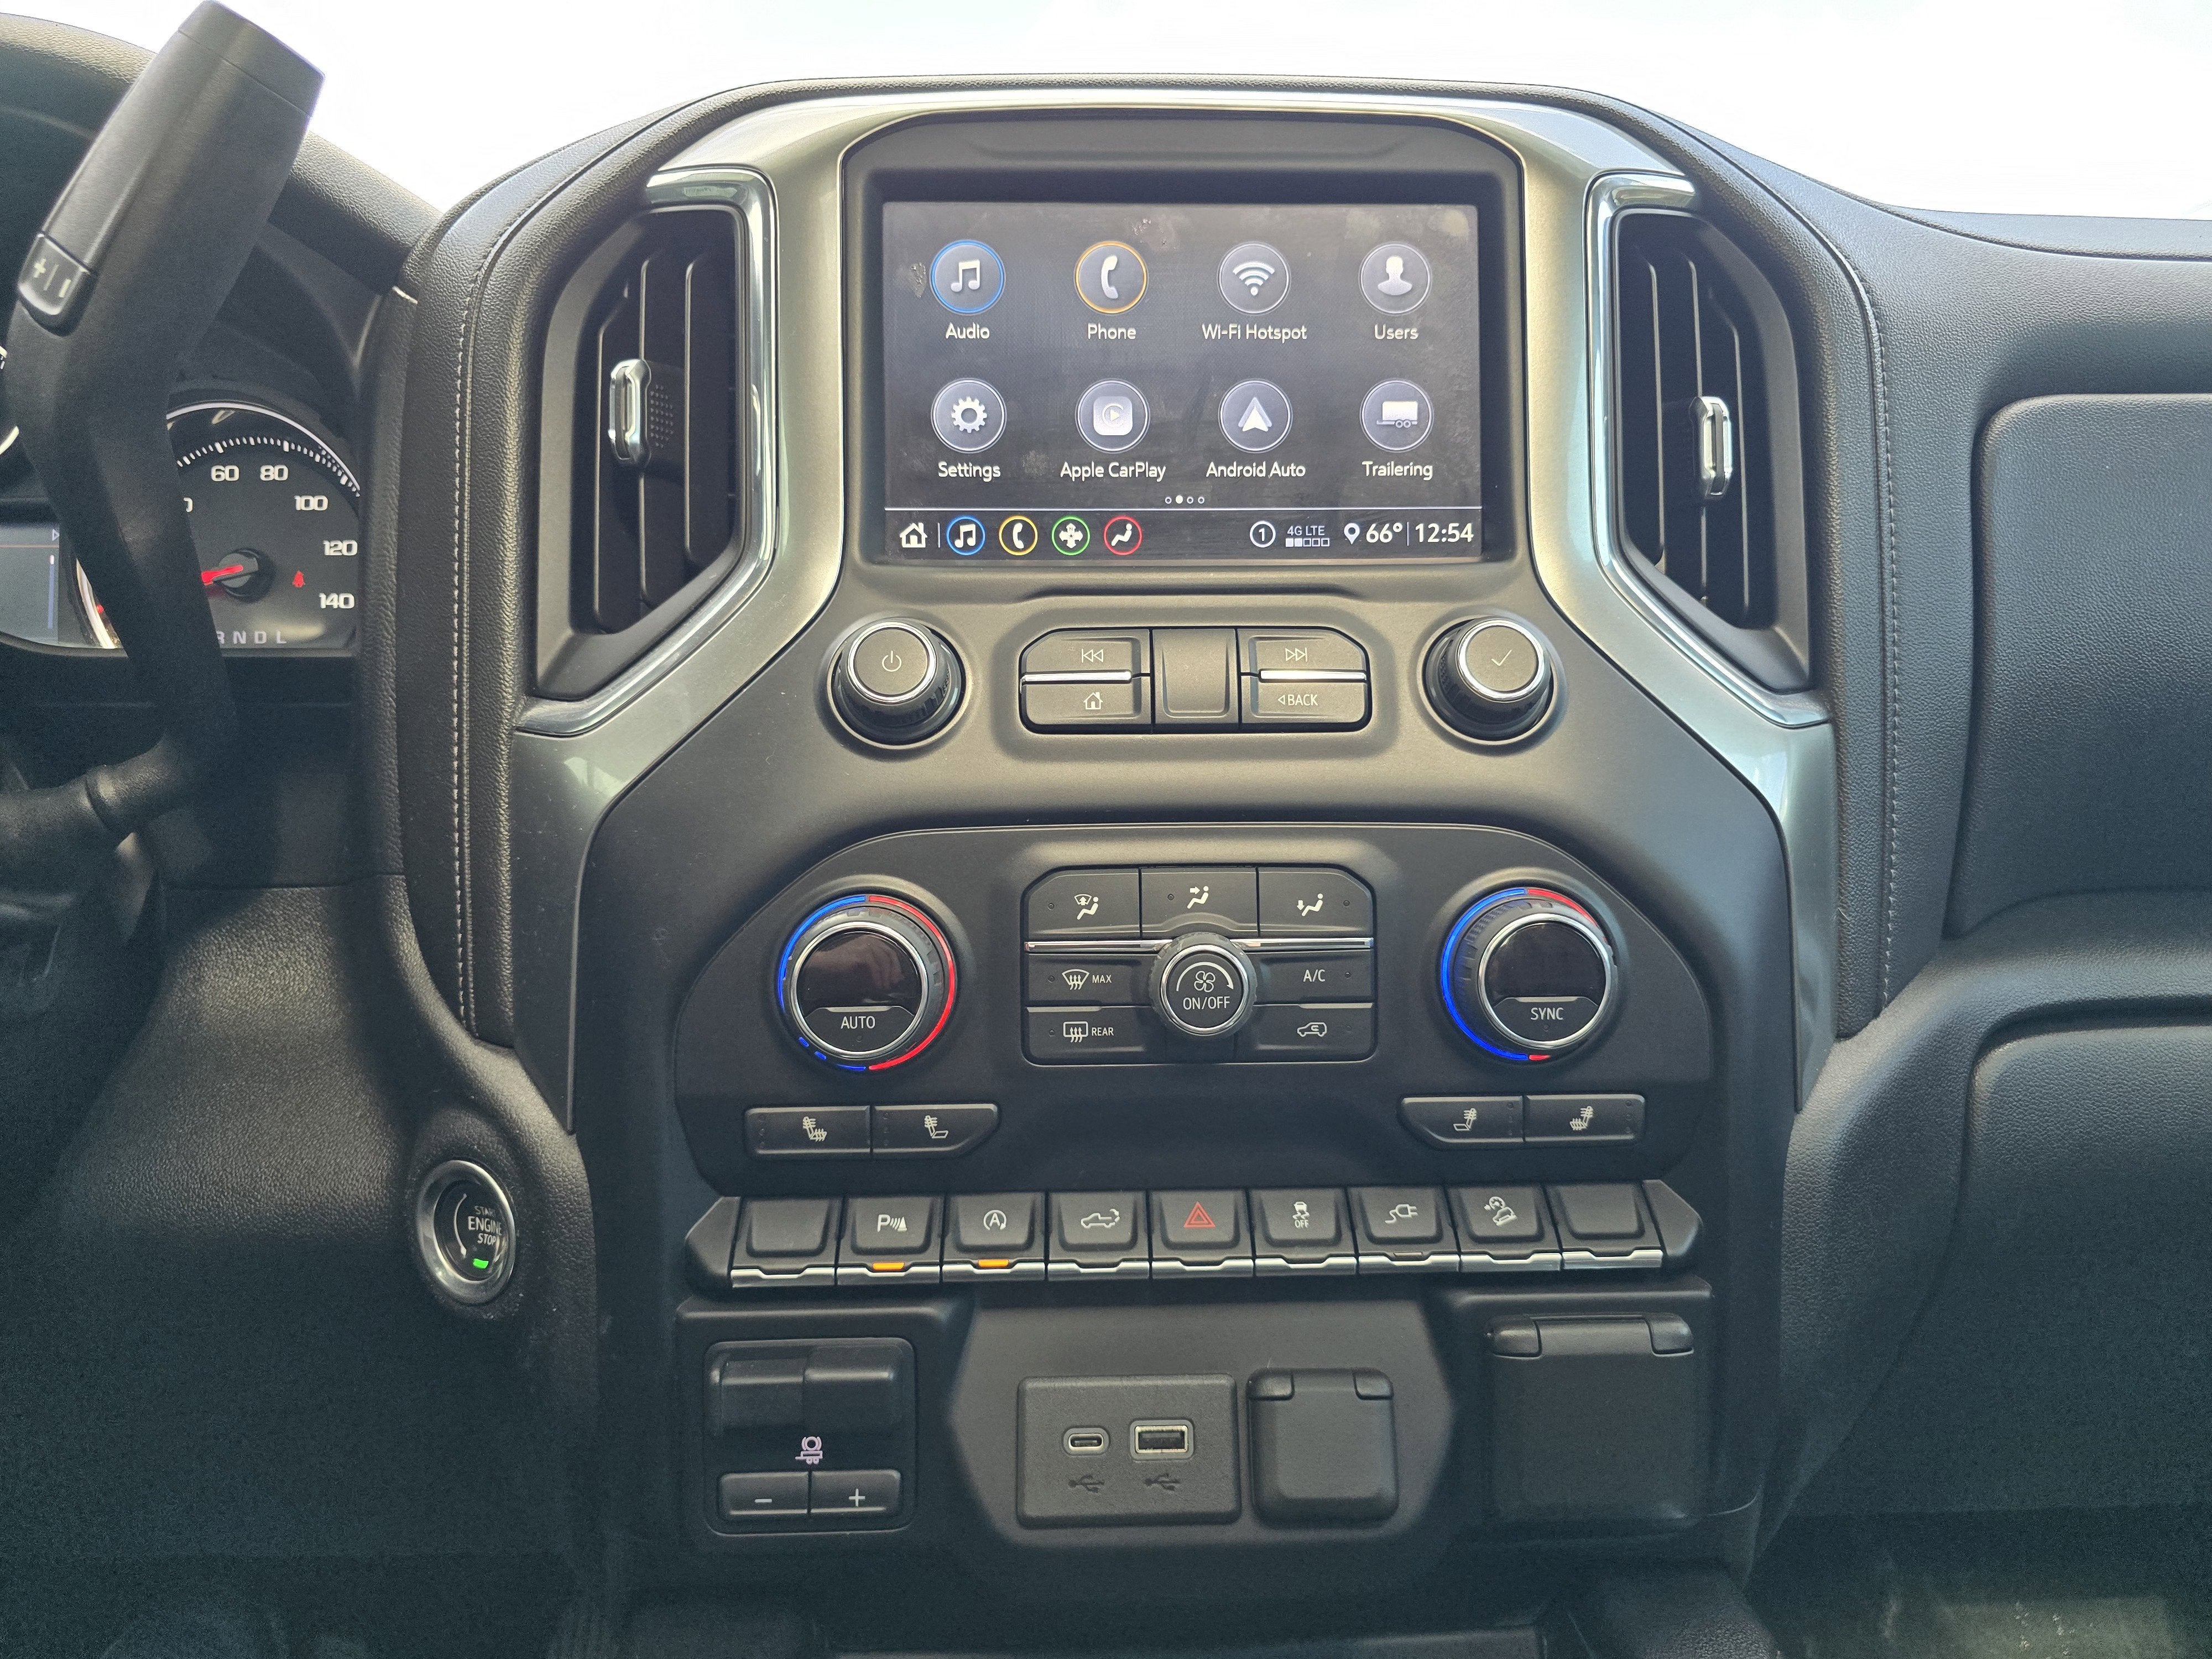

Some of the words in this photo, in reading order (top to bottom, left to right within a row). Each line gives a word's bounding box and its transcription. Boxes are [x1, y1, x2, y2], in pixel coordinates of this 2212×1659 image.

[945, 322, 990, 339] Audio
[1088, 322, 1136, 340] Phone
[1202, 324, 1241, 340] Wi-Fi
[1246, 324, 1307, 344] Hotspot
[1374, 324, 1419, 340] Users
[211, 465, 239, 482] 60
[259, 465, 289, 481] 80
[938, 461, 1001, 482] Settings
[1060, 461, 1104, 482] Apple
[1108, 461, 1166, 482] CarPlay
[1206, 461, 1266, 477] Android
[1269, 461, 1306, 477] Auto
[1361, 461, 1433, 481] Trailering
[294, 495, 328, 511] 100
[1287, 525, 1302, 536] 4G
[1306, 525, 1325, 536] LTE
[1366, 522, 1403, 543] 66°
[1415, 523, 1474, 542] 12:54
[323, 540, 358, 556] 120
[319, 593, 355, 609] 140
[232, 630, 247, 644] N
[254, 630, 267, 644] D
[276, 630, 287, 644] L
[1287, 693, 1318, 706] BACK
[1092, 974, 1112, 984] MAX
[1303, 969, 1326, 982] A/C
[1183, 996, 1230, 1010] ON/OFF
[1530, 1007, 1564, 1020] SYNC
[841, 1015, 875, 1029] AUTO
[1091, 1027, 1114, 1036] REAR
[467, 1215, 502, 1236] ENGINE
[1294, 1219, 1310, 1229] OFF
[477, 1233, 497, 1246] STOP
